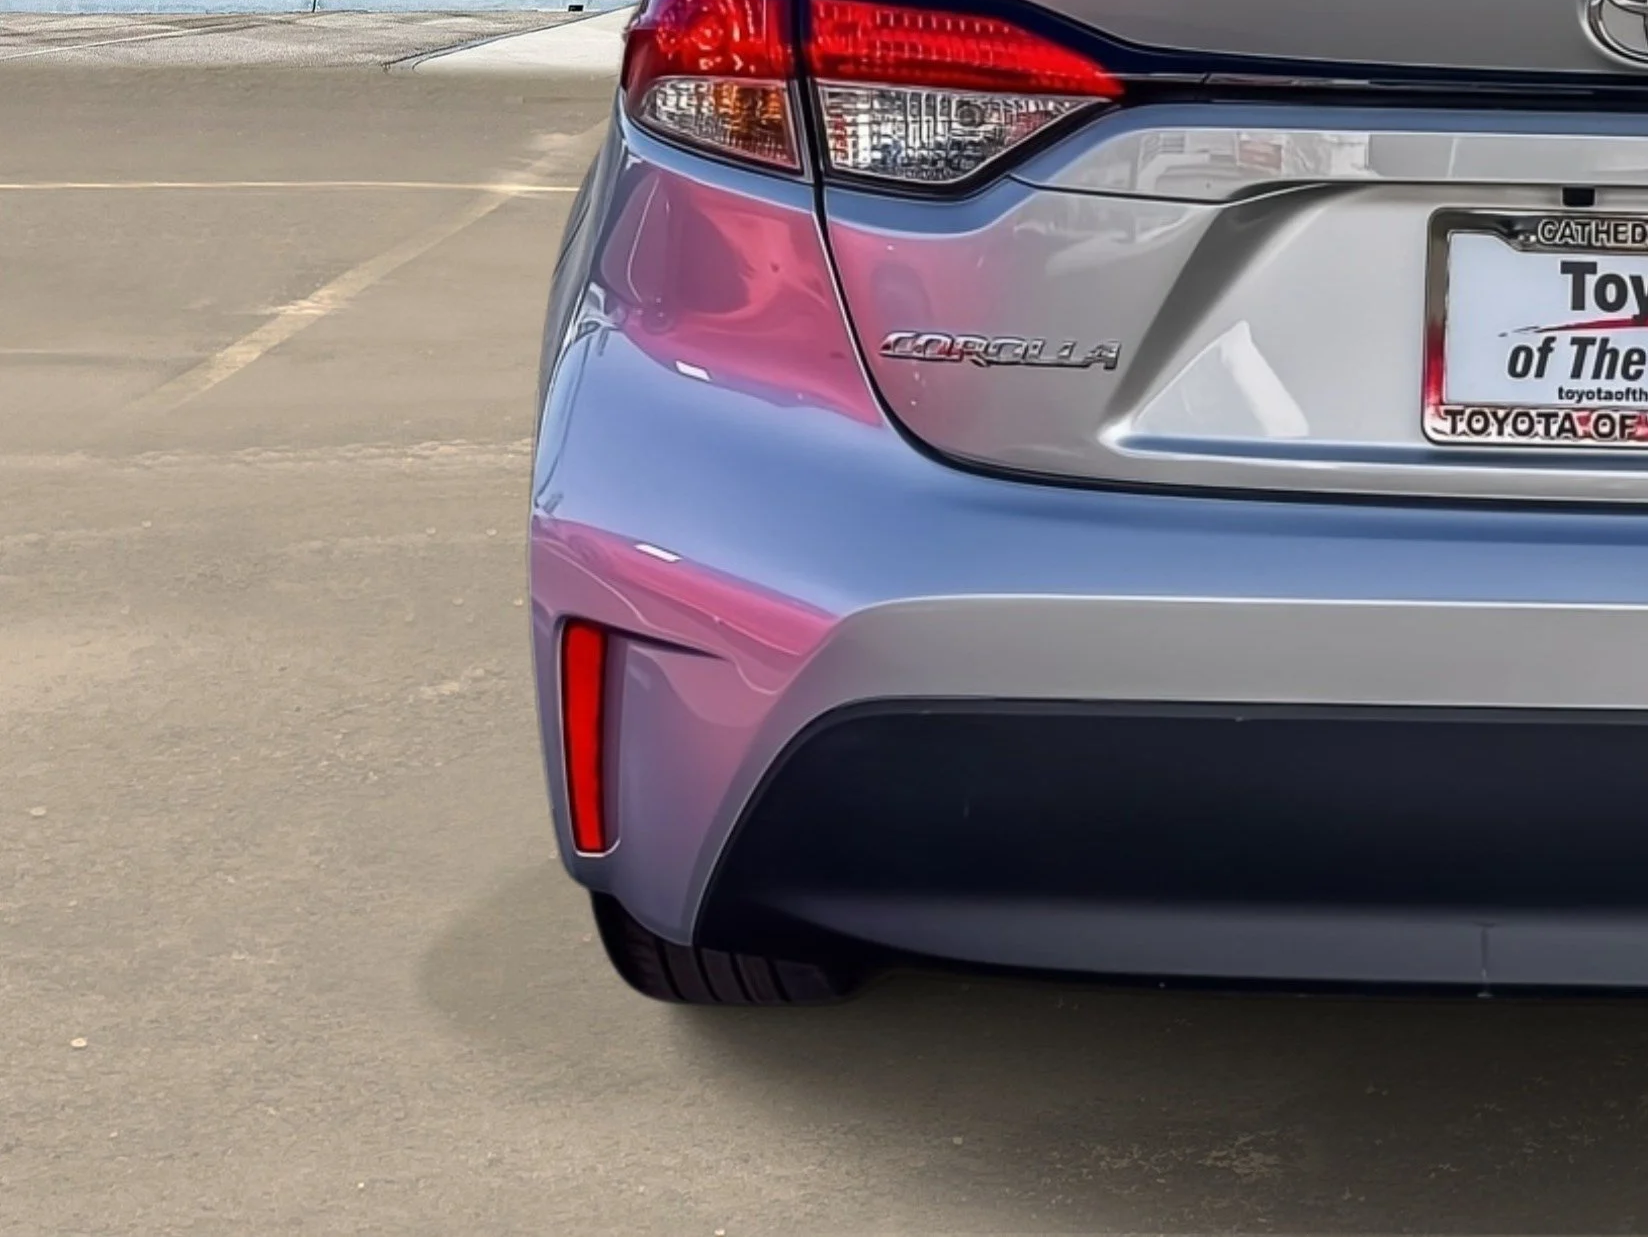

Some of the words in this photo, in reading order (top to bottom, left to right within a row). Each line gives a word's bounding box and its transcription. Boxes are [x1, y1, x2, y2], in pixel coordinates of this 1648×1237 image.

[879, 330, 1122, 370] COROLLA
[1507, 336, 1557, 379] of
[1569, 338, 1647, 381] The
[1443, 408, 1579, 439] TOYOTA
[1591, 411, 1640, 439] OF
